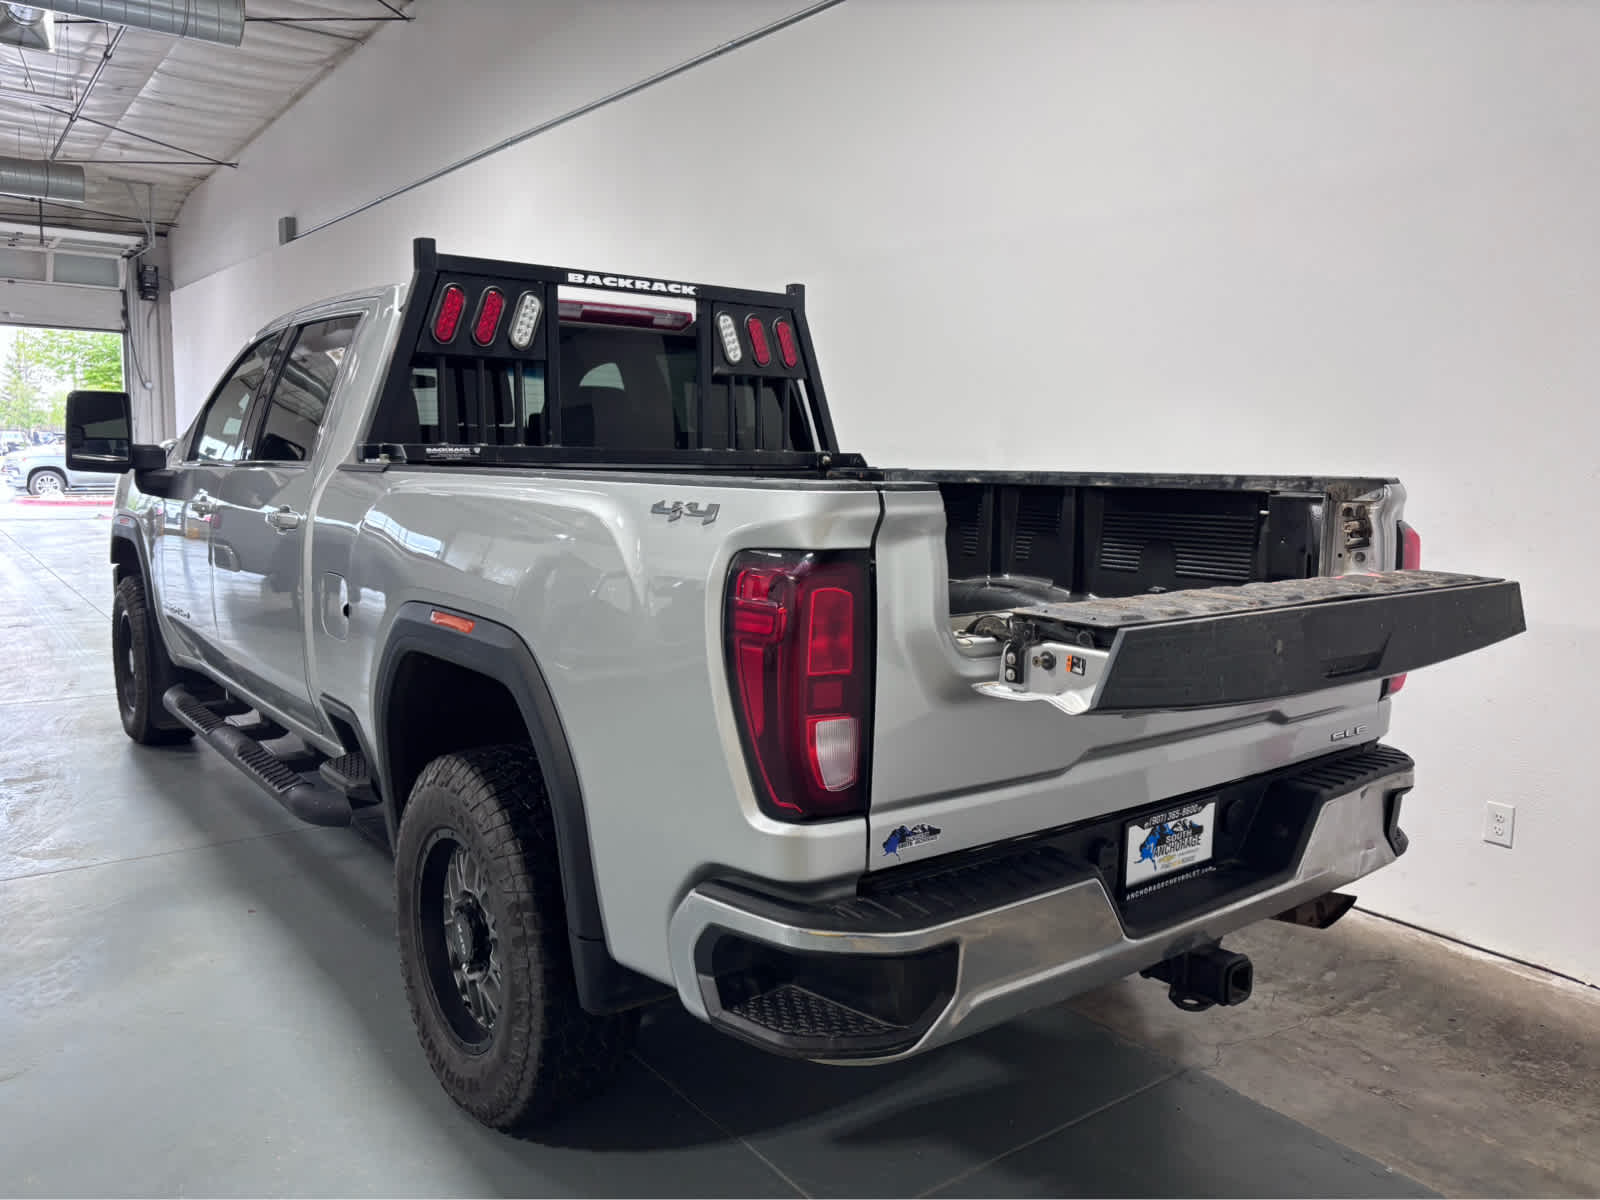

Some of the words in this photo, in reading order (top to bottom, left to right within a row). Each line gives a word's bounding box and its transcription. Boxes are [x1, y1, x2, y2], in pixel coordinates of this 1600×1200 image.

[567, 272, 697, 295] BACKRACK
[1154, 833, 1202, 857] ANCHORAGE
[1165, 829, 1193, 843] SOUTH
